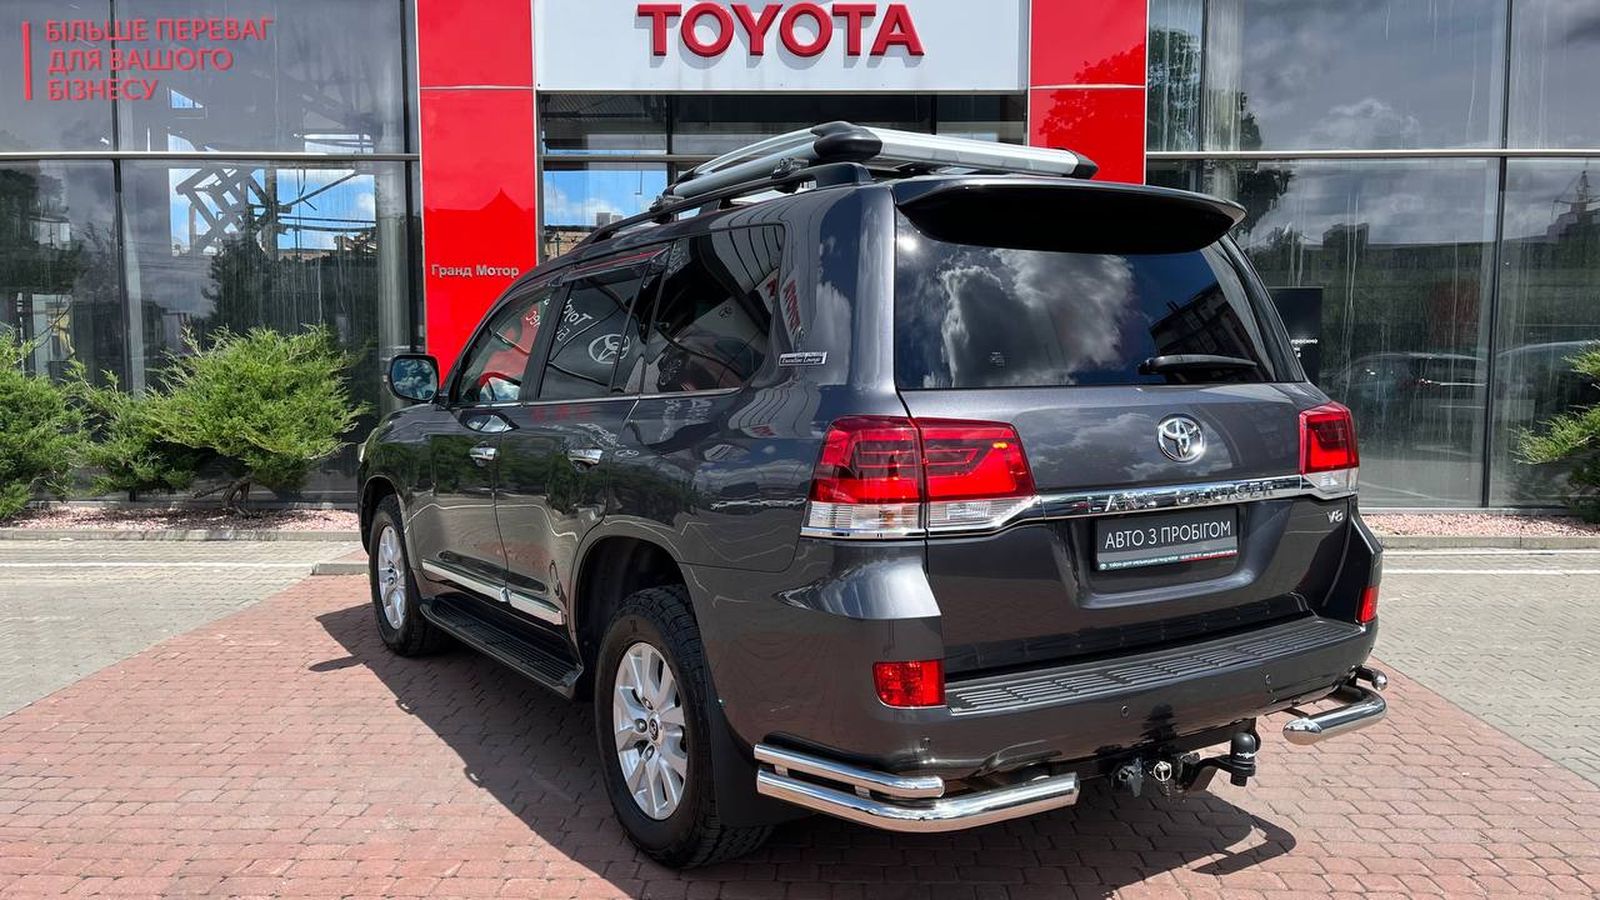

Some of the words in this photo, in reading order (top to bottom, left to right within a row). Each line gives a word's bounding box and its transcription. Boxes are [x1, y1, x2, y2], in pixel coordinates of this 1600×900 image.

[45, 19, 149, 42] БІЛЬШЕ
[155, 18, 273, 41] ПЕРЕВАГ
[637, 2, 925, 58] TOYOTA
[47, 48, 102, 75] ДЛЯ
[109, 47, 235, 72] ВАШОГО
[47, 79, 159, 101] БІЗНЕСУ
[431, 264, 473, 279] Гранд
[476, 264, 520, 279] Мотор
[1326, 509, 1344, 523] V8
[1104, 529, 1146, 550] АВТО
[1160, 520, 1232, 544] ПРОБІГОМ
